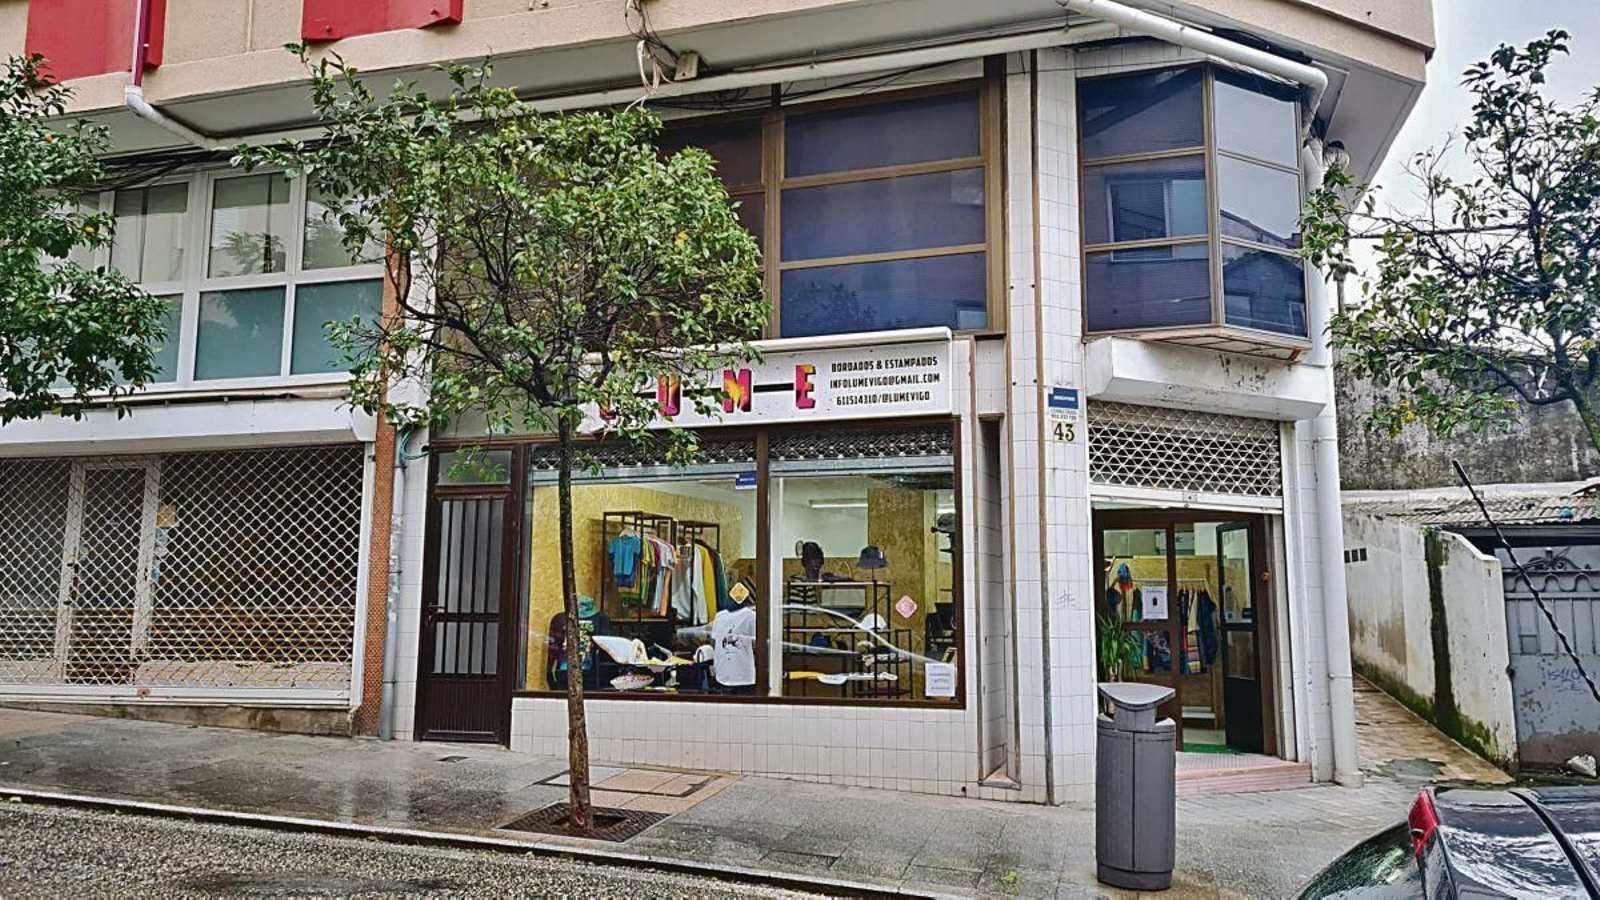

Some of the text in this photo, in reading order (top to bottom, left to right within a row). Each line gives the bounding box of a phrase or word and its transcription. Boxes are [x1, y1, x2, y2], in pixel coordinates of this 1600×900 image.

[831, 356, 938, 373] BORDADOS & ESTAMPADOS
[830, 372, 940, 389] INFOLUMEVIGO@GMAIL.COM
[1054, 422, 1075, 441] 43
